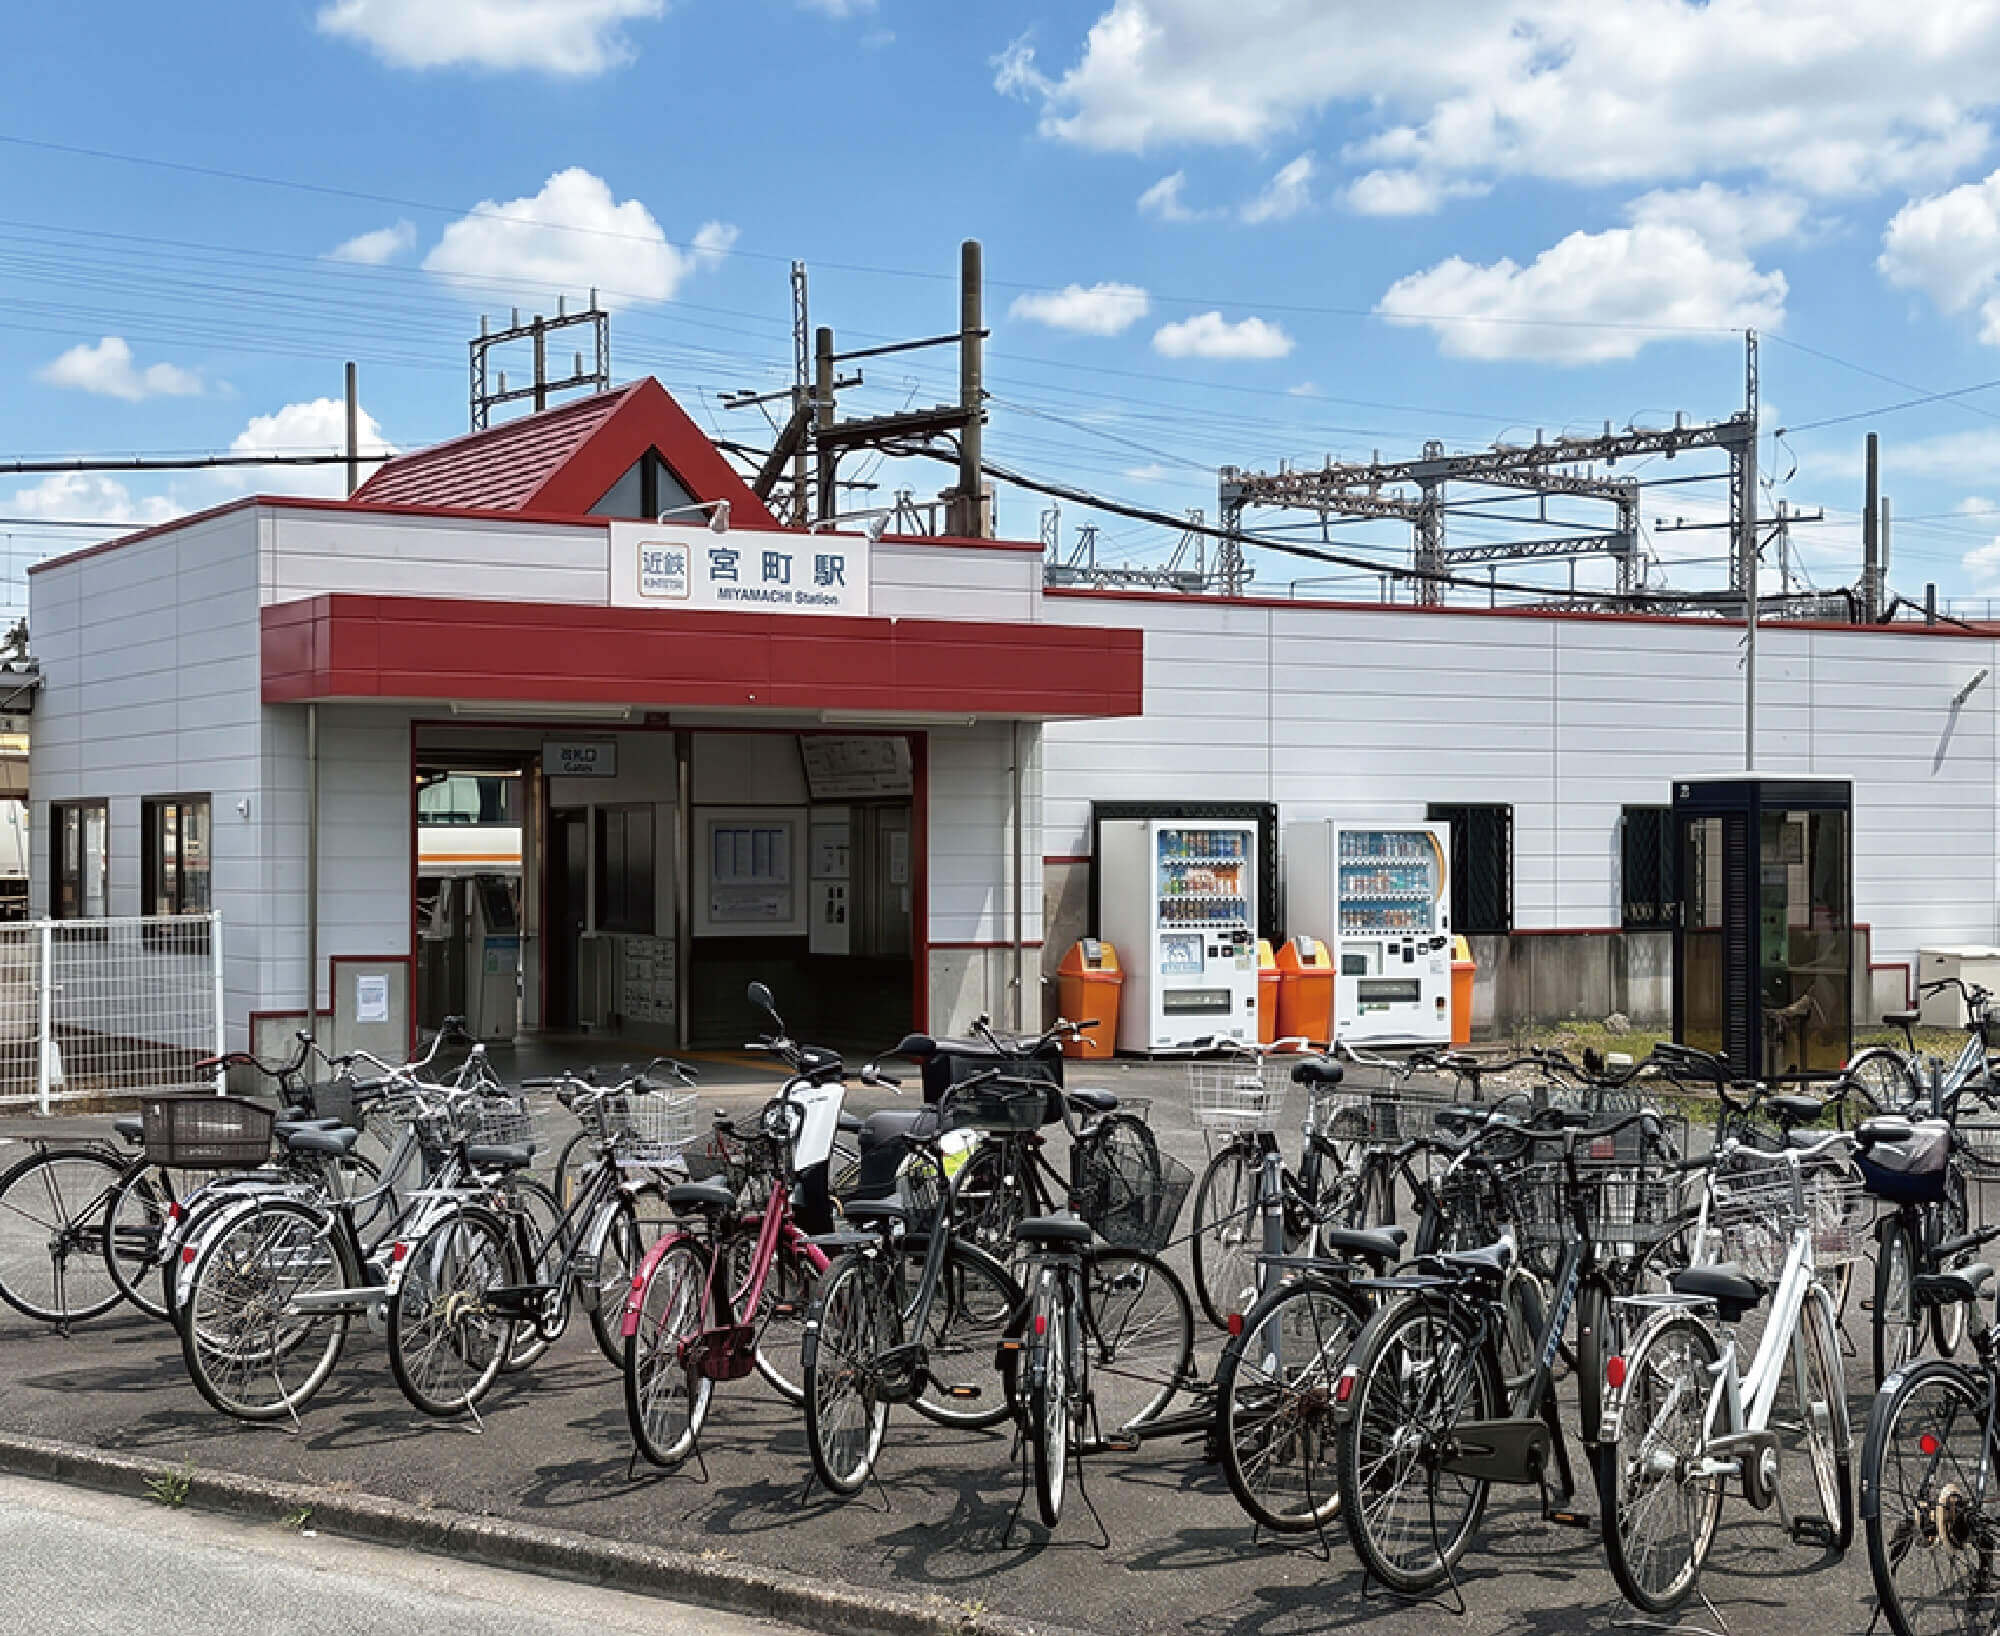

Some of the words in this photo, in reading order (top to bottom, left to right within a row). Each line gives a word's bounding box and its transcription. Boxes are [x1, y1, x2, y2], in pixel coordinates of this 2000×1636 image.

[643, 551, 684, 576] 近鉄
[708, 548, 844, 585] 宮町駅
[717, 587, 792, 602] MIYAMACHI
[795, 591, 838, 606] Station
